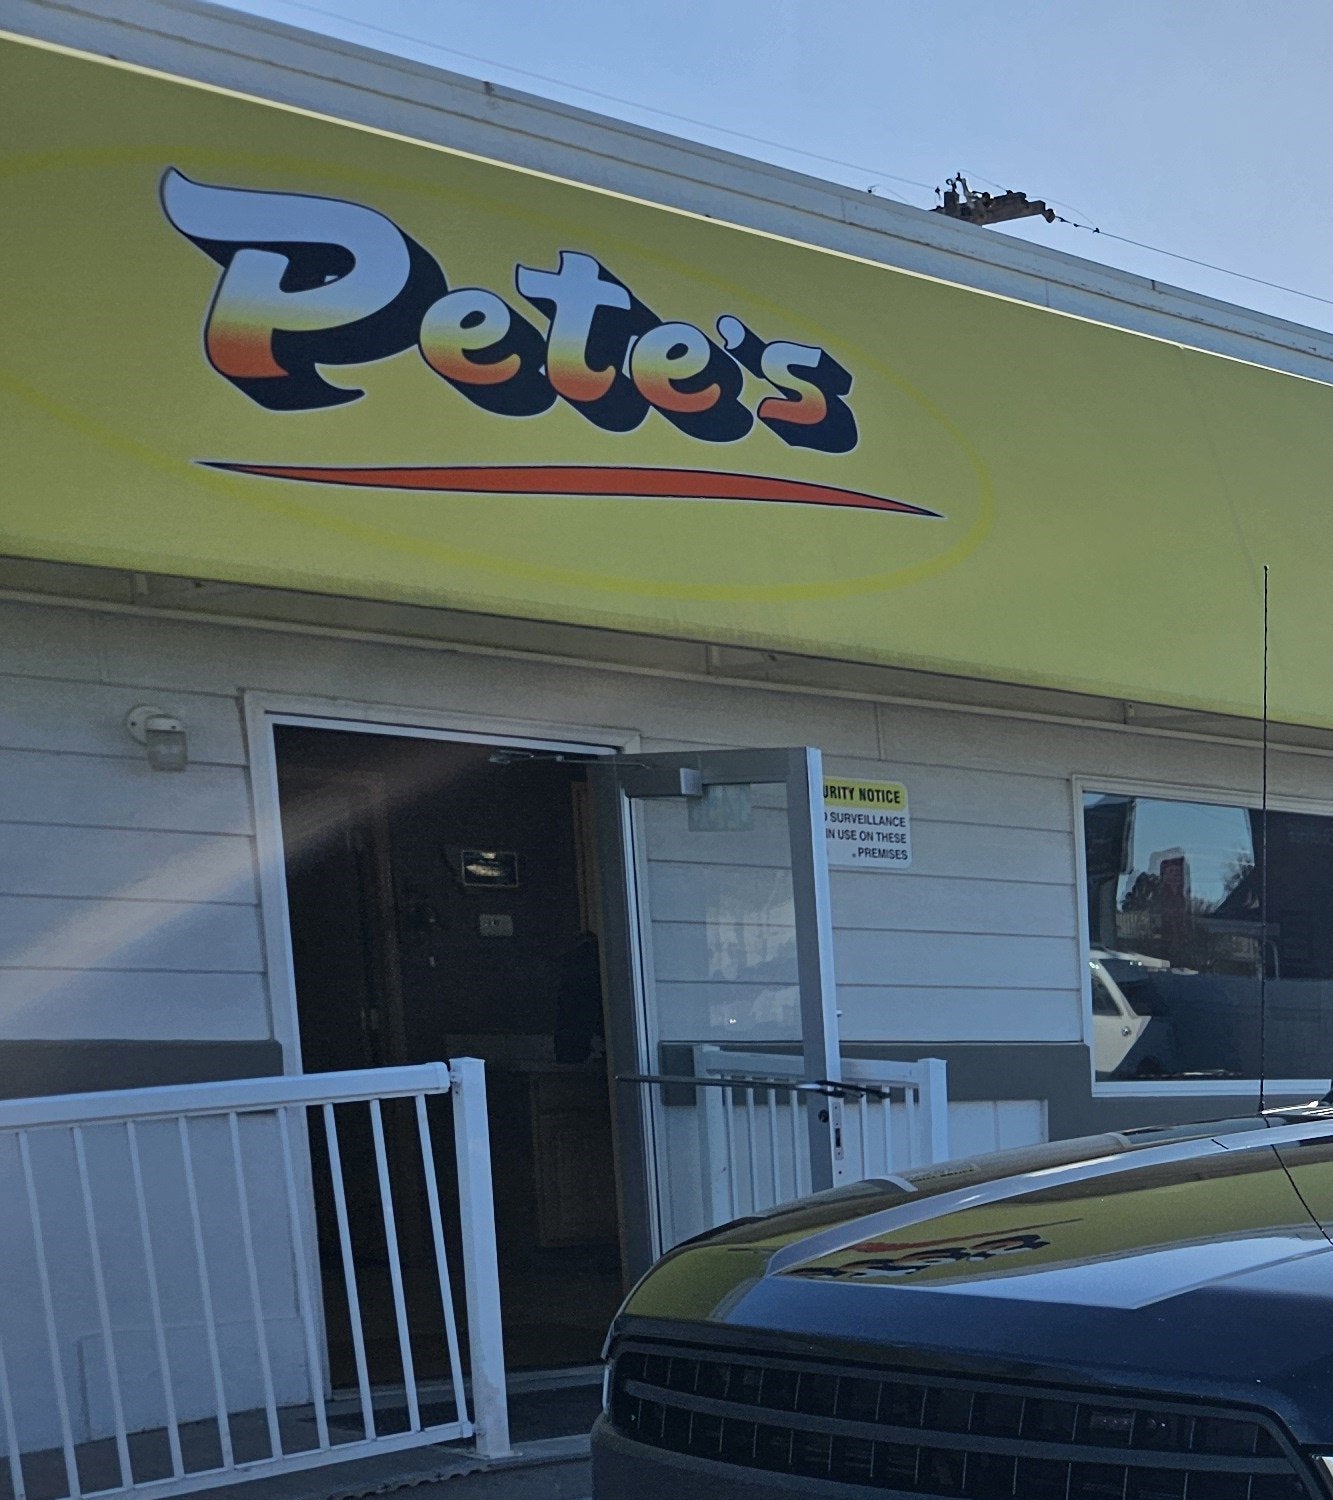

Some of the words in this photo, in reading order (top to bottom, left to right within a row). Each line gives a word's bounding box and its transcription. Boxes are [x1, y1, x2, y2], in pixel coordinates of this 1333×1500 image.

[160, 166, 857, 453] Pete's
[858, 788, 901, 804] NOTICE
[830, 811, 906, 828] SURVEILLANCE
[825, 827, 836, 840] IN
[837, 829, 858, 842] USE
[859, 830, 874, 842] ON
[876, 831, 907, 844] THESE
[857, 847, 909, 861] PREMISES
